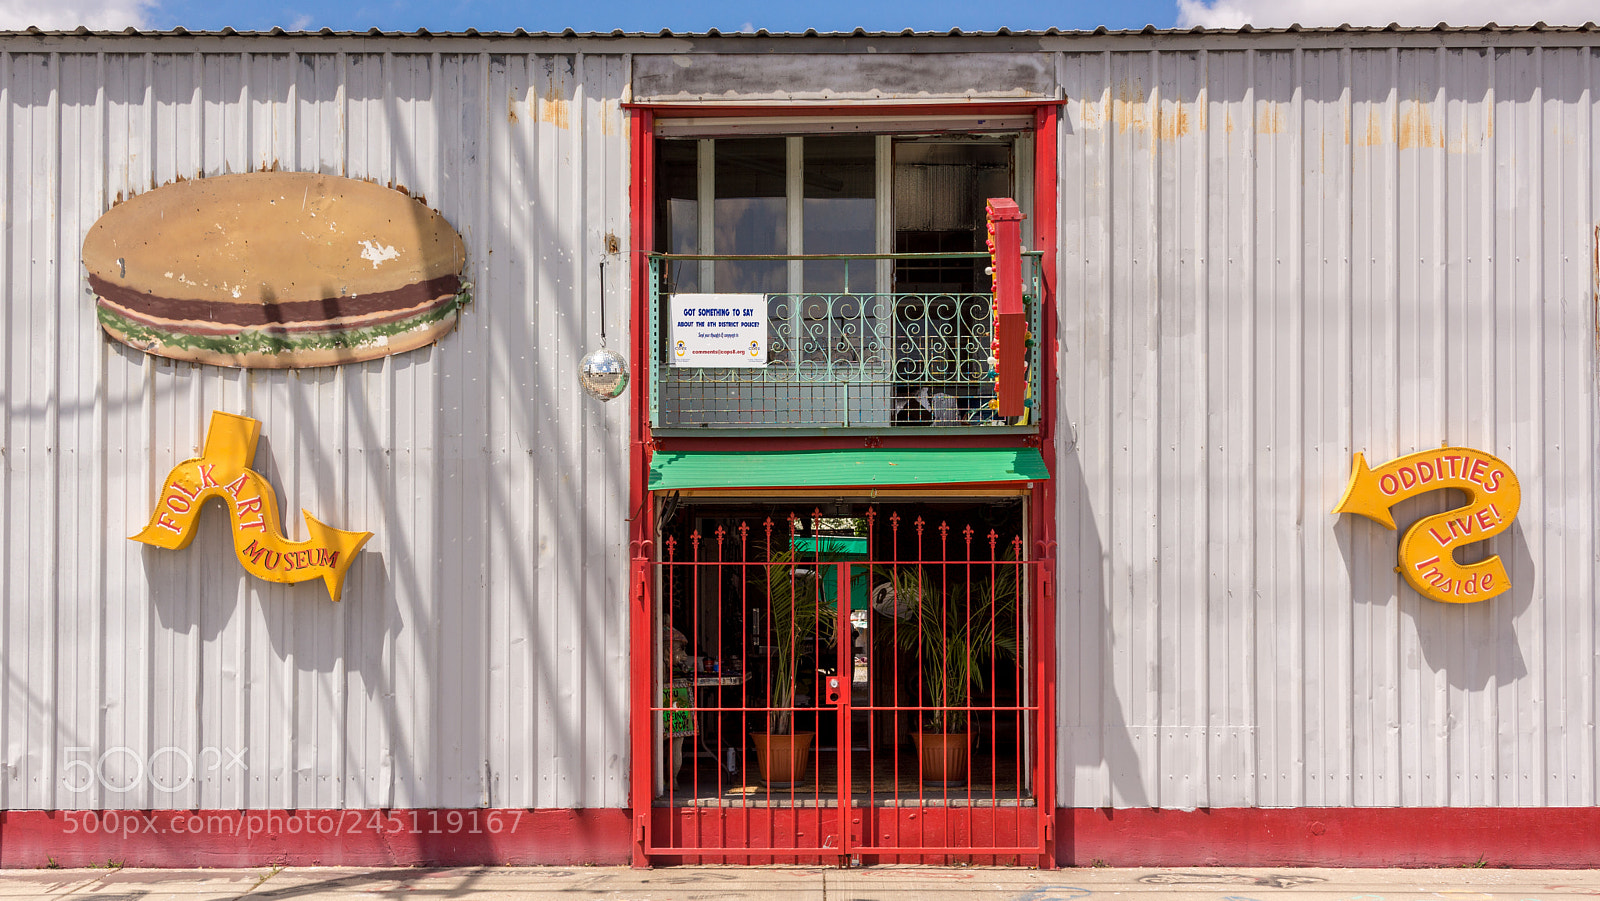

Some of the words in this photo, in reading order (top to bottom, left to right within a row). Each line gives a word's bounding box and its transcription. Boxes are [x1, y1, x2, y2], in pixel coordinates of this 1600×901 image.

[683, 308, 696, 317] GOT
[698, 308, 730, 317] SOMETHING
[732, 308, 740, 317] TO
[743, 308, 754, 317] SAY
[1380, 456, 1504, 495] ODDITIES
[156, 463, 219, 535] FOLK
[223, 473, 267, 534] ART
[1429, 503, 1502, 547] LIVE!
[242, 539, 341, 572] MUSEUM
[1415, 555, 1495, 596] Inside
